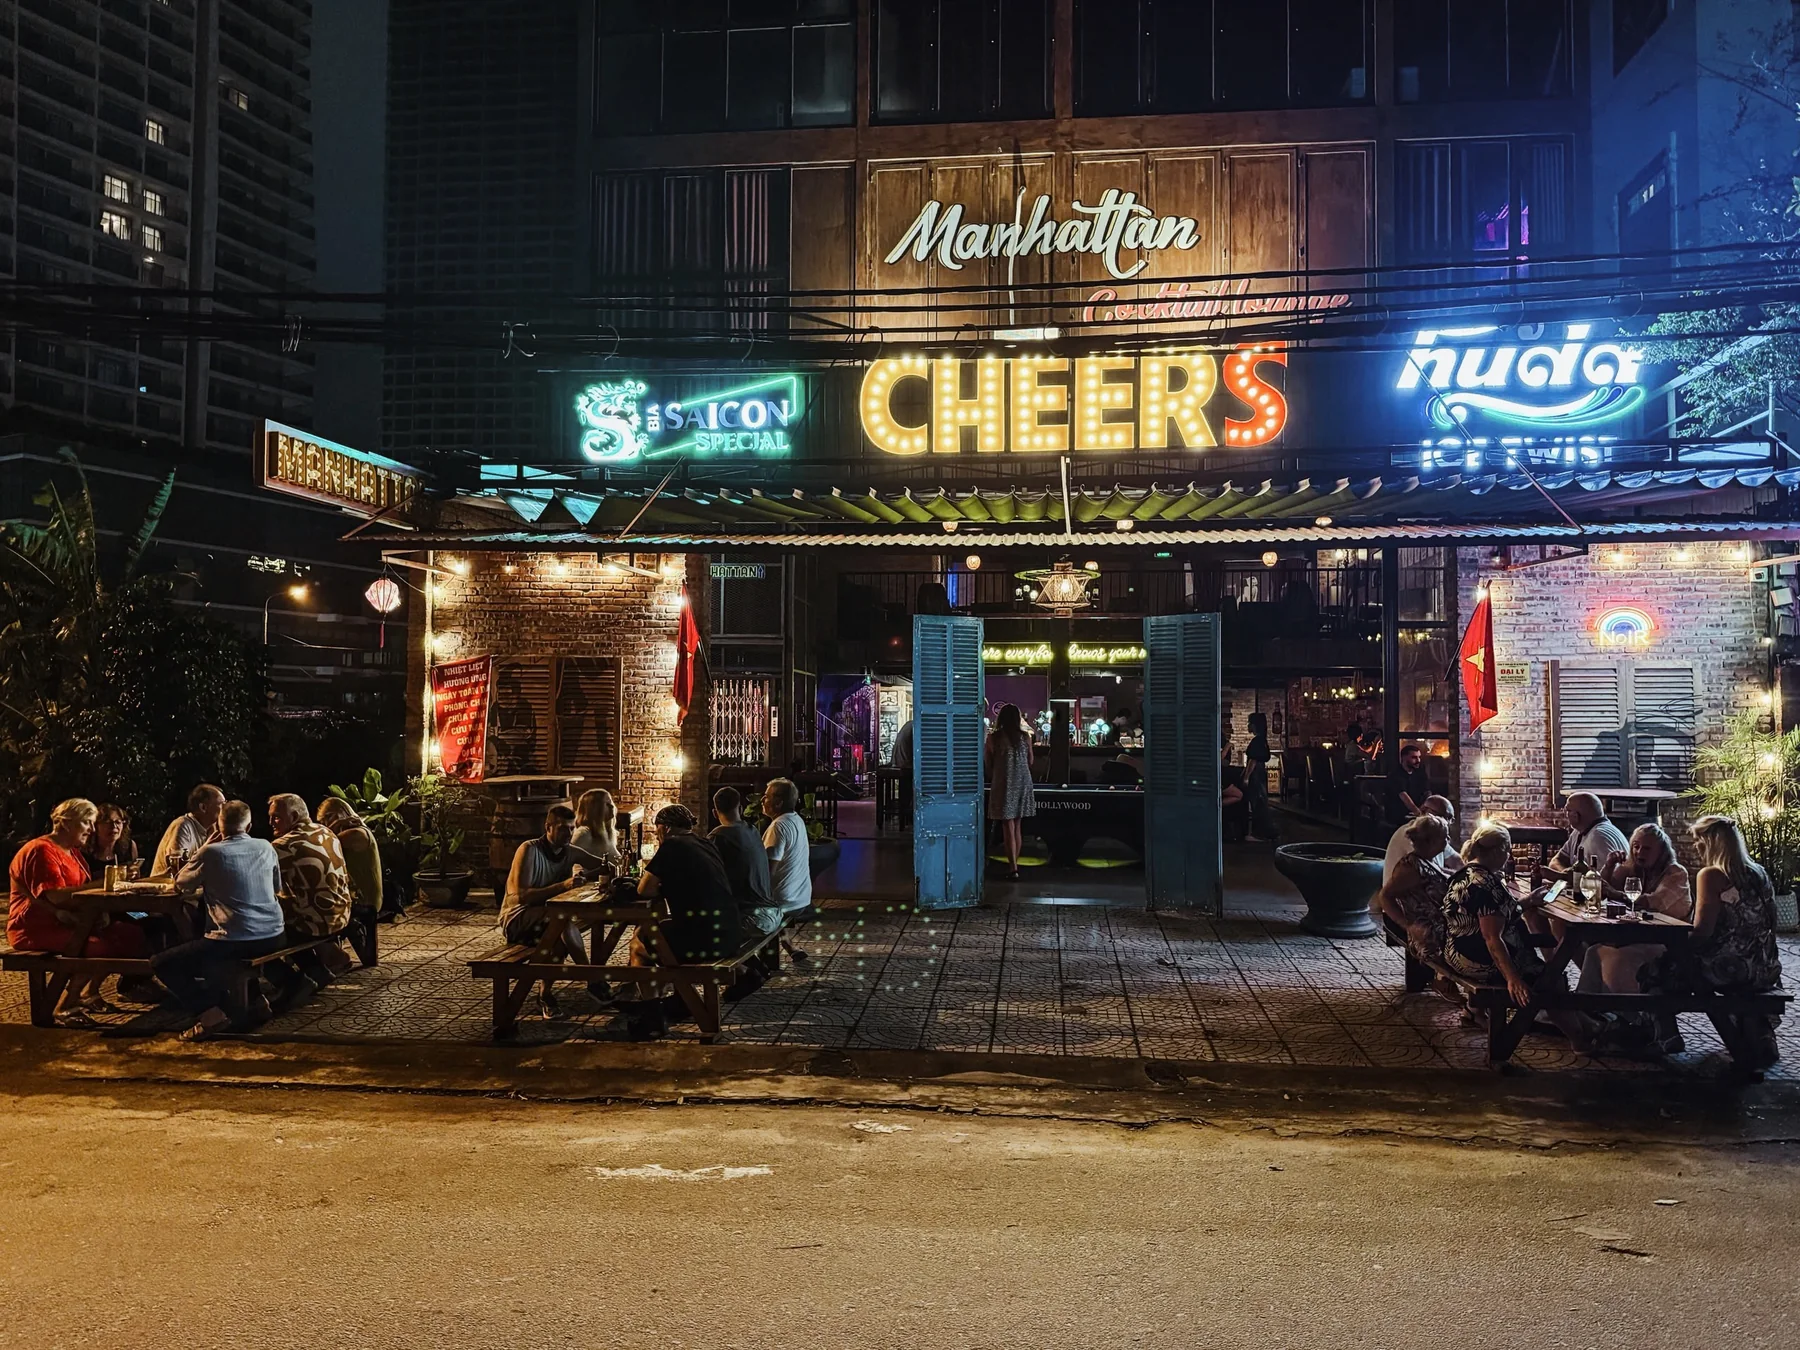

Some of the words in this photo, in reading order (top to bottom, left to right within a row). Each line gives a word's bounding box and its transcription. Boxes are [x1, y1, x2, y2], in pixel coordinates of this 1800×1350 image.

[884, 188, 1201, 279] Manhattan
[1083, 277, 1232, 327] Cocktail
[647, 403, 661, 432] BIA
[859, 341, 1288, 455] CHEERS
[695, 432, 790, 452] SPECIAL
[270, 431, 425, 514] MANHATTA
[1034, 801, 1091, 810] HOLLYWOOD
